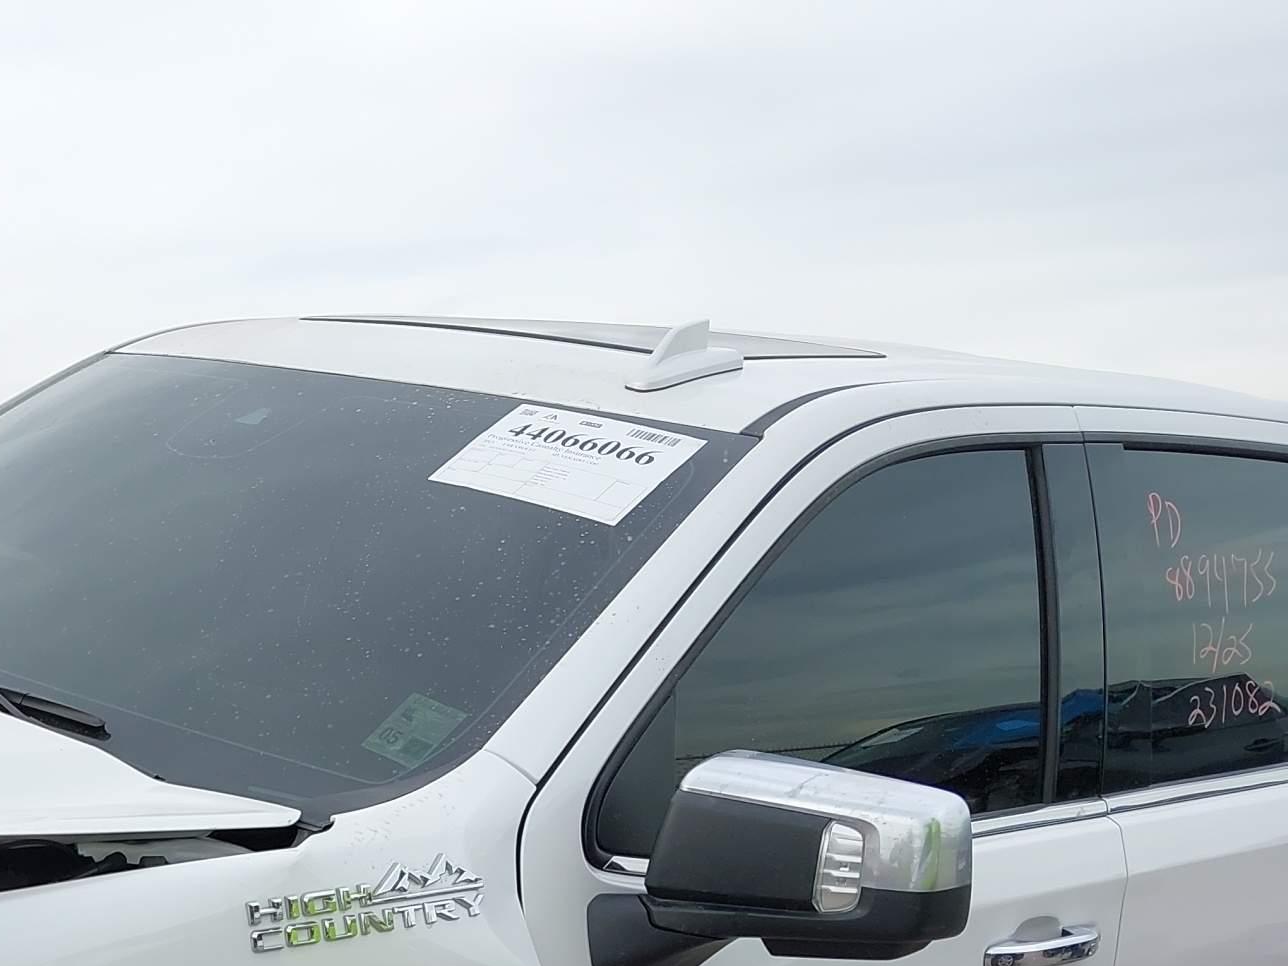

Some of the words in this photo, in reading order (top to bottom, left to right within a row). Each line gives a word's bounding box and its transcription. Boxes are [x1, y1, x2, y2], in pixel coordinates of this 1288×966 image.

[508, 423, 664, 466] 44066066
[1146, 492, 1181, 548] PD
[1188, 681, 1281, 728] 231082
[246, 883, 374, 927] HIGH
[249, 894, 485, 954] COUNTRY
